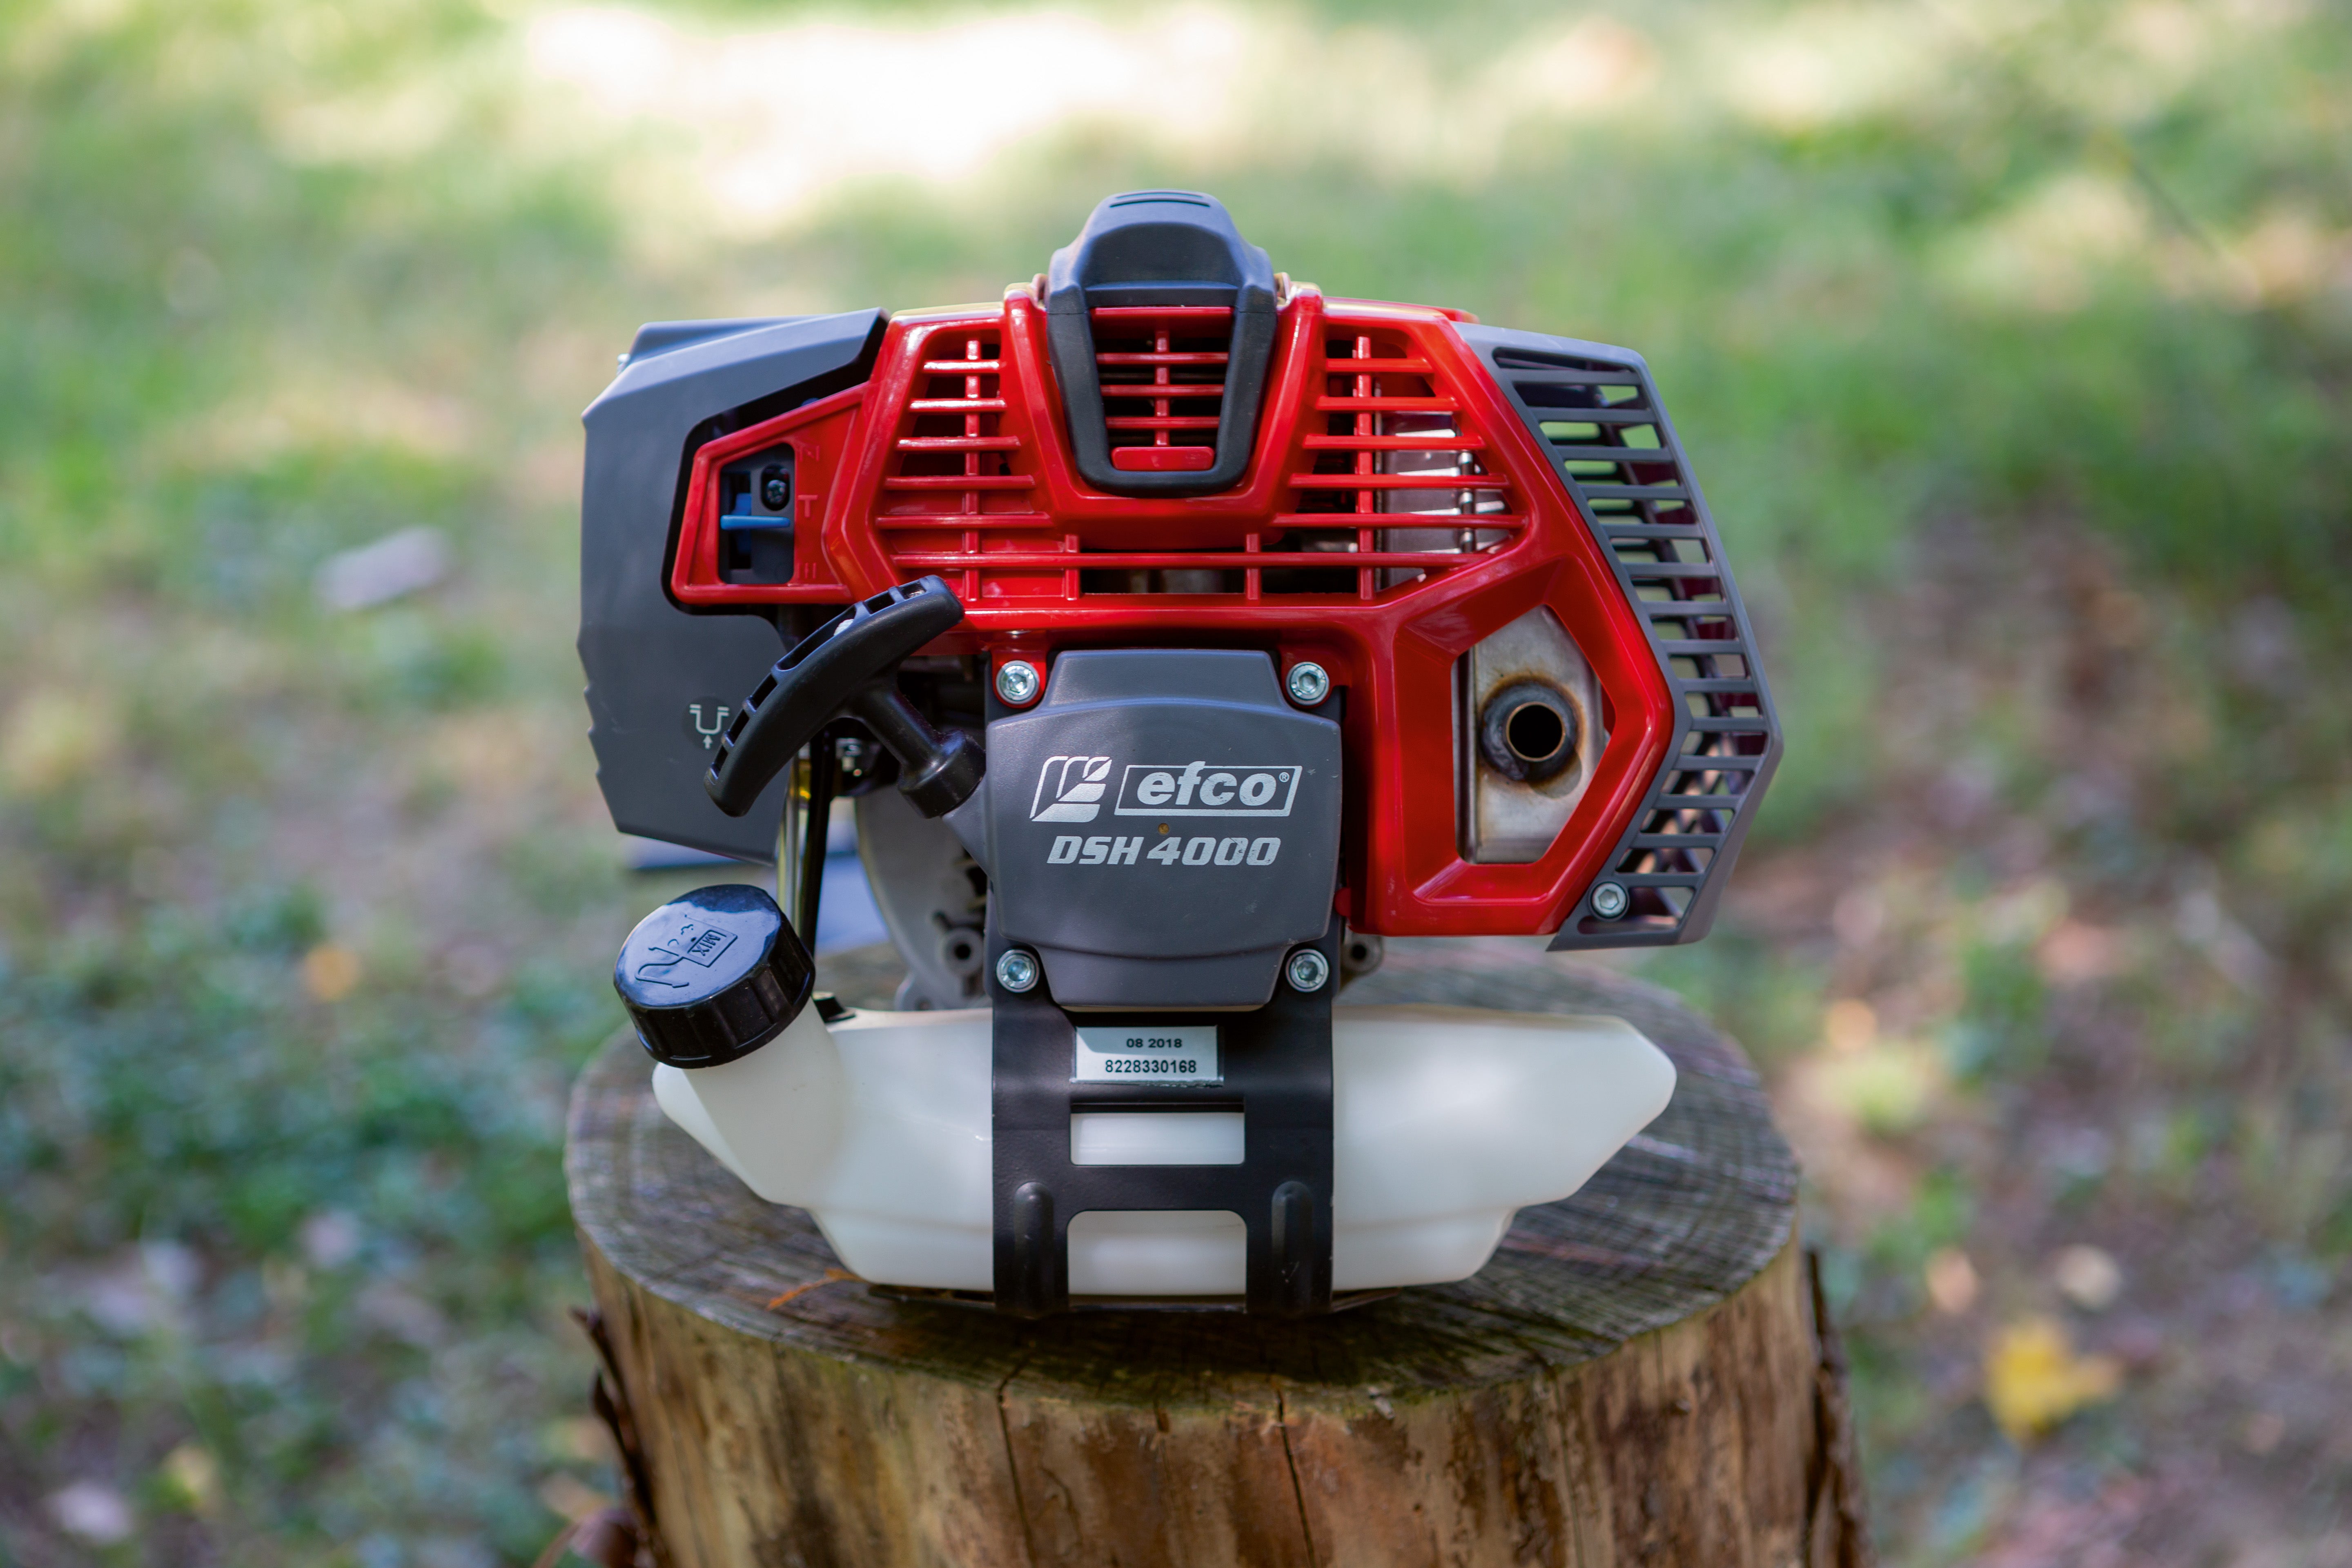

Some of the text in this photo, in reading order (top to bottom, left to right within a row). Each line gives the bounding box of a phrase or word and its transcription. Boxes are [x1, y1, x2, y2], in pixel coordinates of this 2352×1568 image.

[799, 494, 818, 517] T
[1047, 836, 1281, 866] DSH 4000
[692, 934, 721, 956] MIX
[1126, 1038, 1182, 1048] 08 2018
[1105, 1060, 1196, 1073] 8228330168
